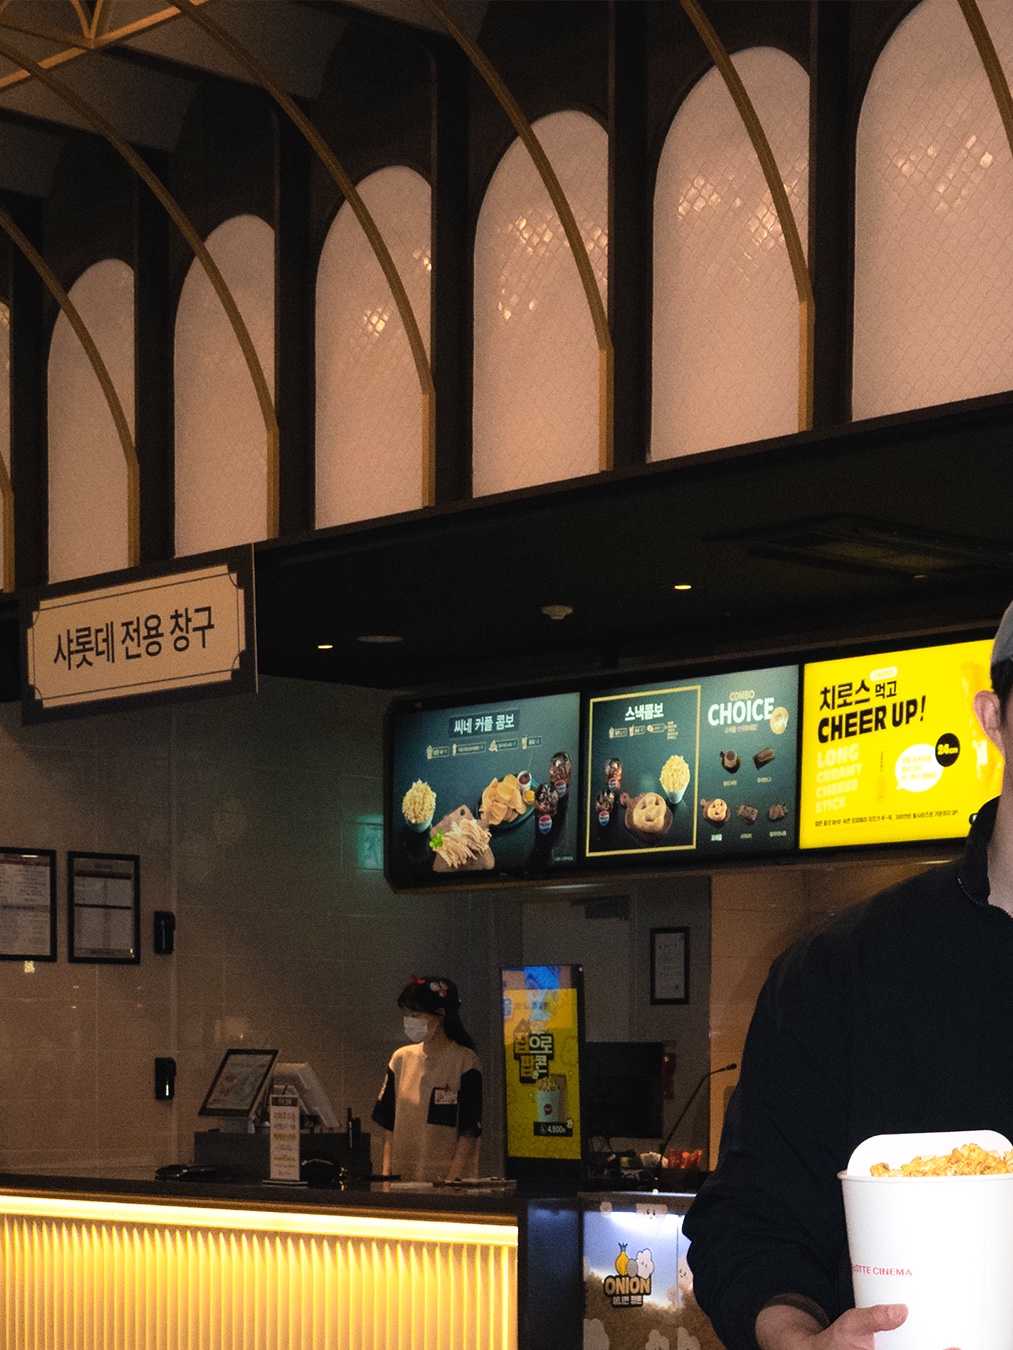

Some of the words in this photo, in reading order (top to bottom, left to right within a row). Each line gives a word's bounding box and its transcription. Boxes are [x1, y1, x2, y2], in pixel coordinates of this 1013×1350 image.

[53, 621, 115, 671] 샤롯데
[121, 609, 164, 660] 전용
[169, 600, 215, 653] 창구
[729, 690, 755, 701] COMBO
[819, 680, 870, 711] 치로스
[875, 681, 897, 700] 먹고
[624, 703, 664, 721] 스낵콤보
[707, 697, 774, 726] CHOICE
[818, 705, 887, 744] CHEER
[892, 695, 926, 728] UP!
[453, 717, 473, 735] 씨네
[475, 716, 494, 733] 커플
[495, 713, 515, 731] 콤보
[816, 743, 860, 769] LONG
[816, 762, 862, 784] CREAMY
[816, 778, 858, 799] CHEESE
[815, 796, 846, 814] STICK
[872, 1266, 913, 1277] CINEMA
[604, 1276, 651, 1295] ONION
